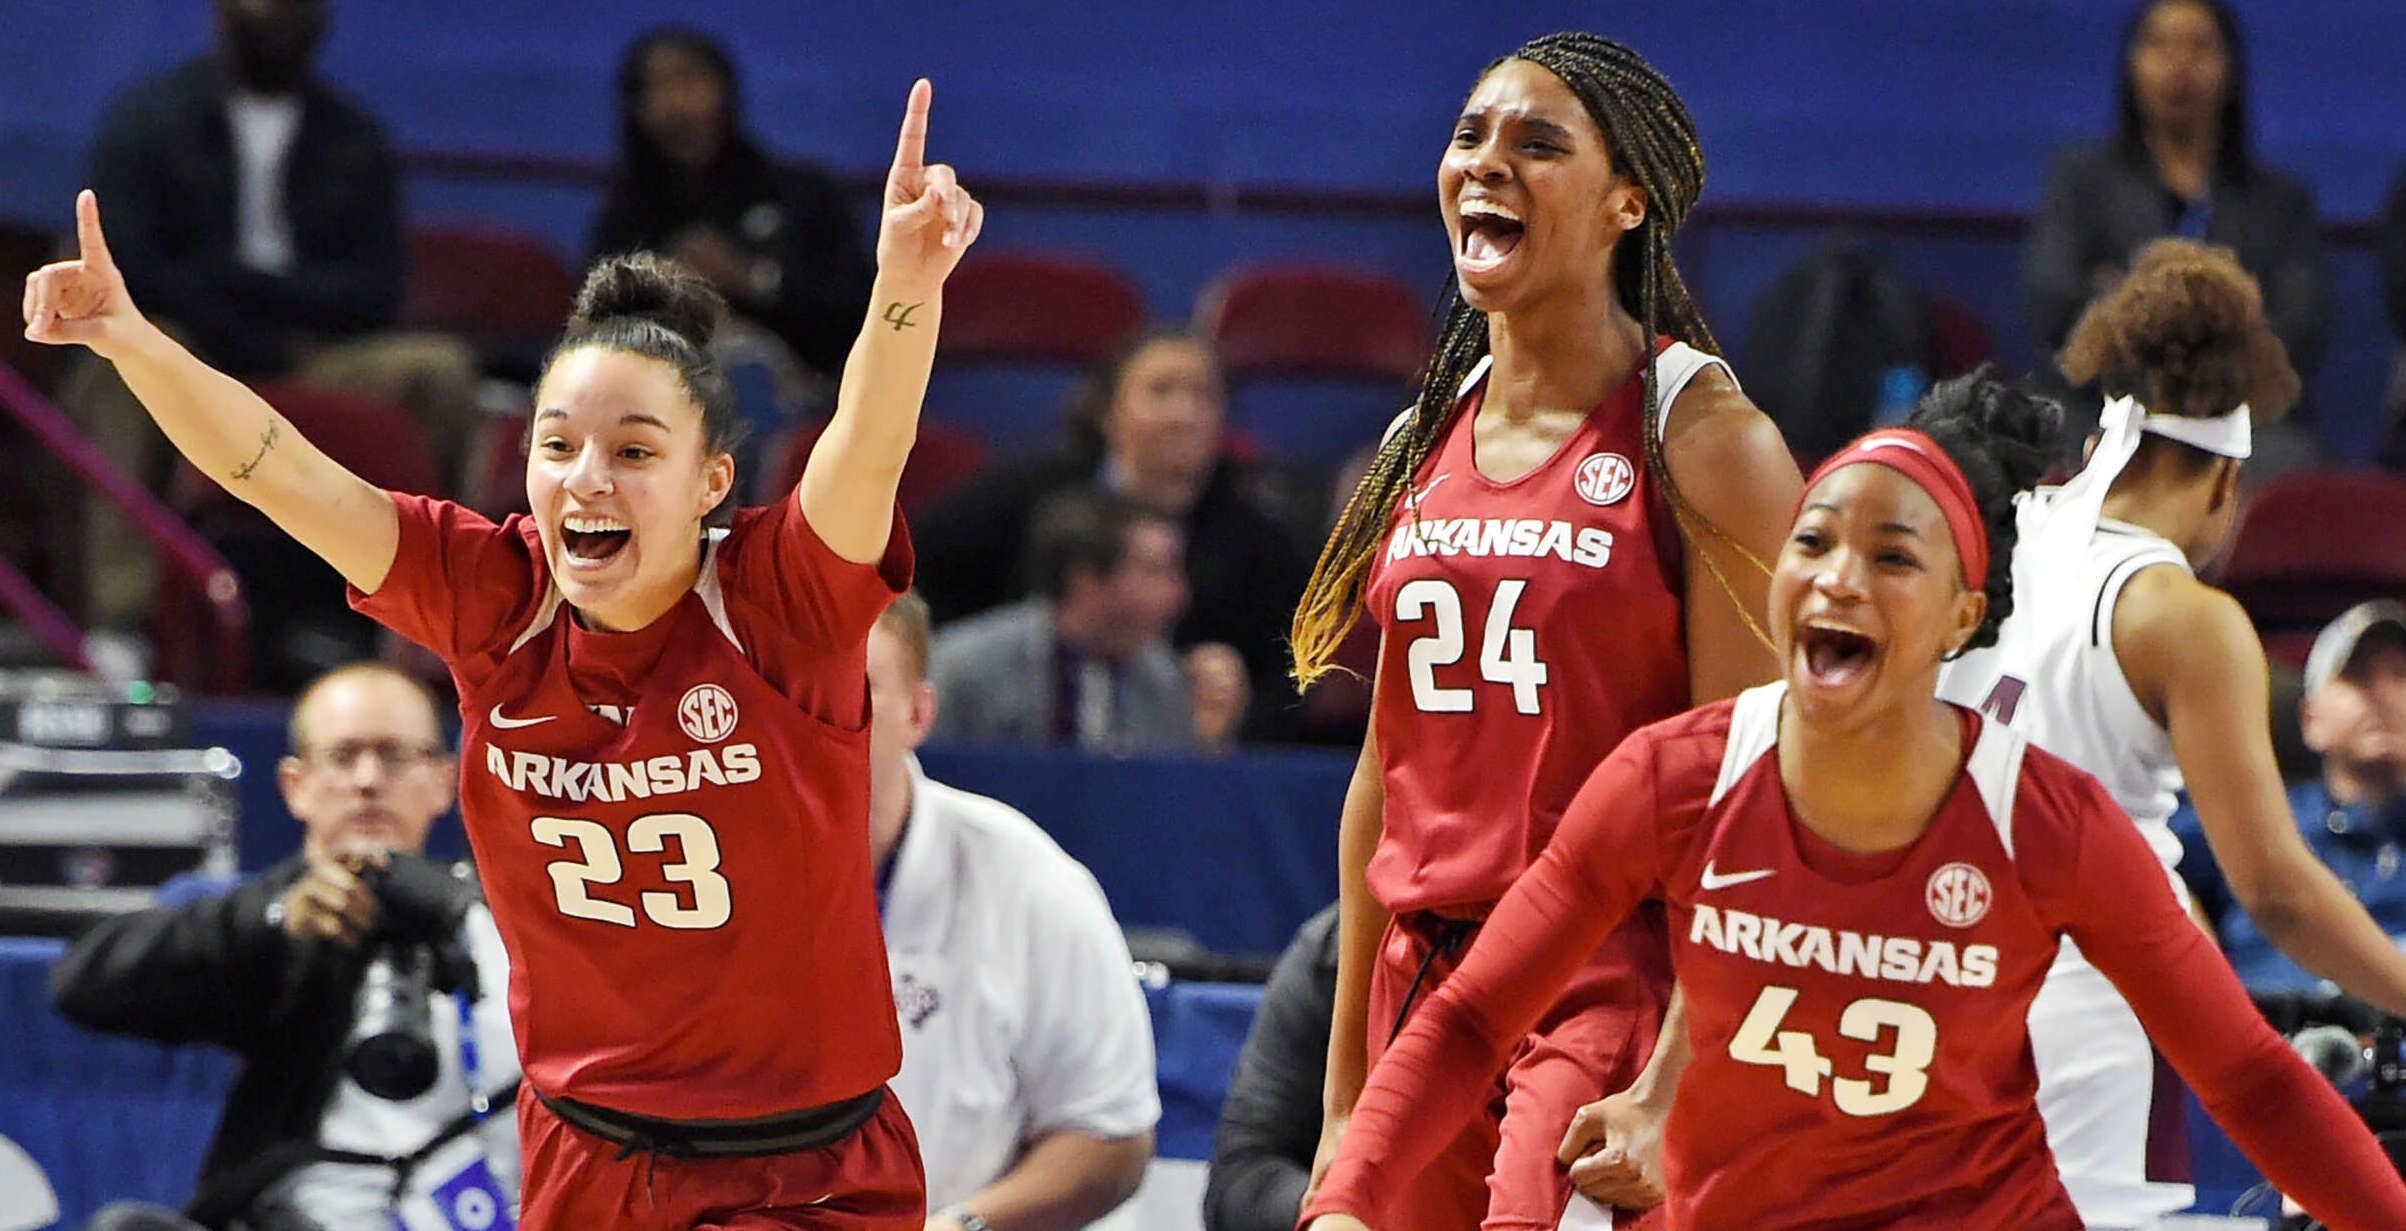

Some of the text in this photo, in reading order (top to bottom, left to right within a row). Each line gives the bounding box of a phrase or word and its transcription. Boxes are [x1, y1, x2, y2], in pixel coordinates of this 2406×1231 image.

[1580, 458, 1630, 500] SEC
[1385, 518, 1613, 568] ARKANSAS
[1395, 580, 1548, 715] 24
[682, 688, 732, 739] SEC
[486, 743, 761, 802] ARKANSAS
[530, 814, 733, 929] 23
[1934, 868, 1986, 922] SEC
[1690, 904, 1998, 988] ARKANSAS
[1728, 986, 1938, 1117] 43
